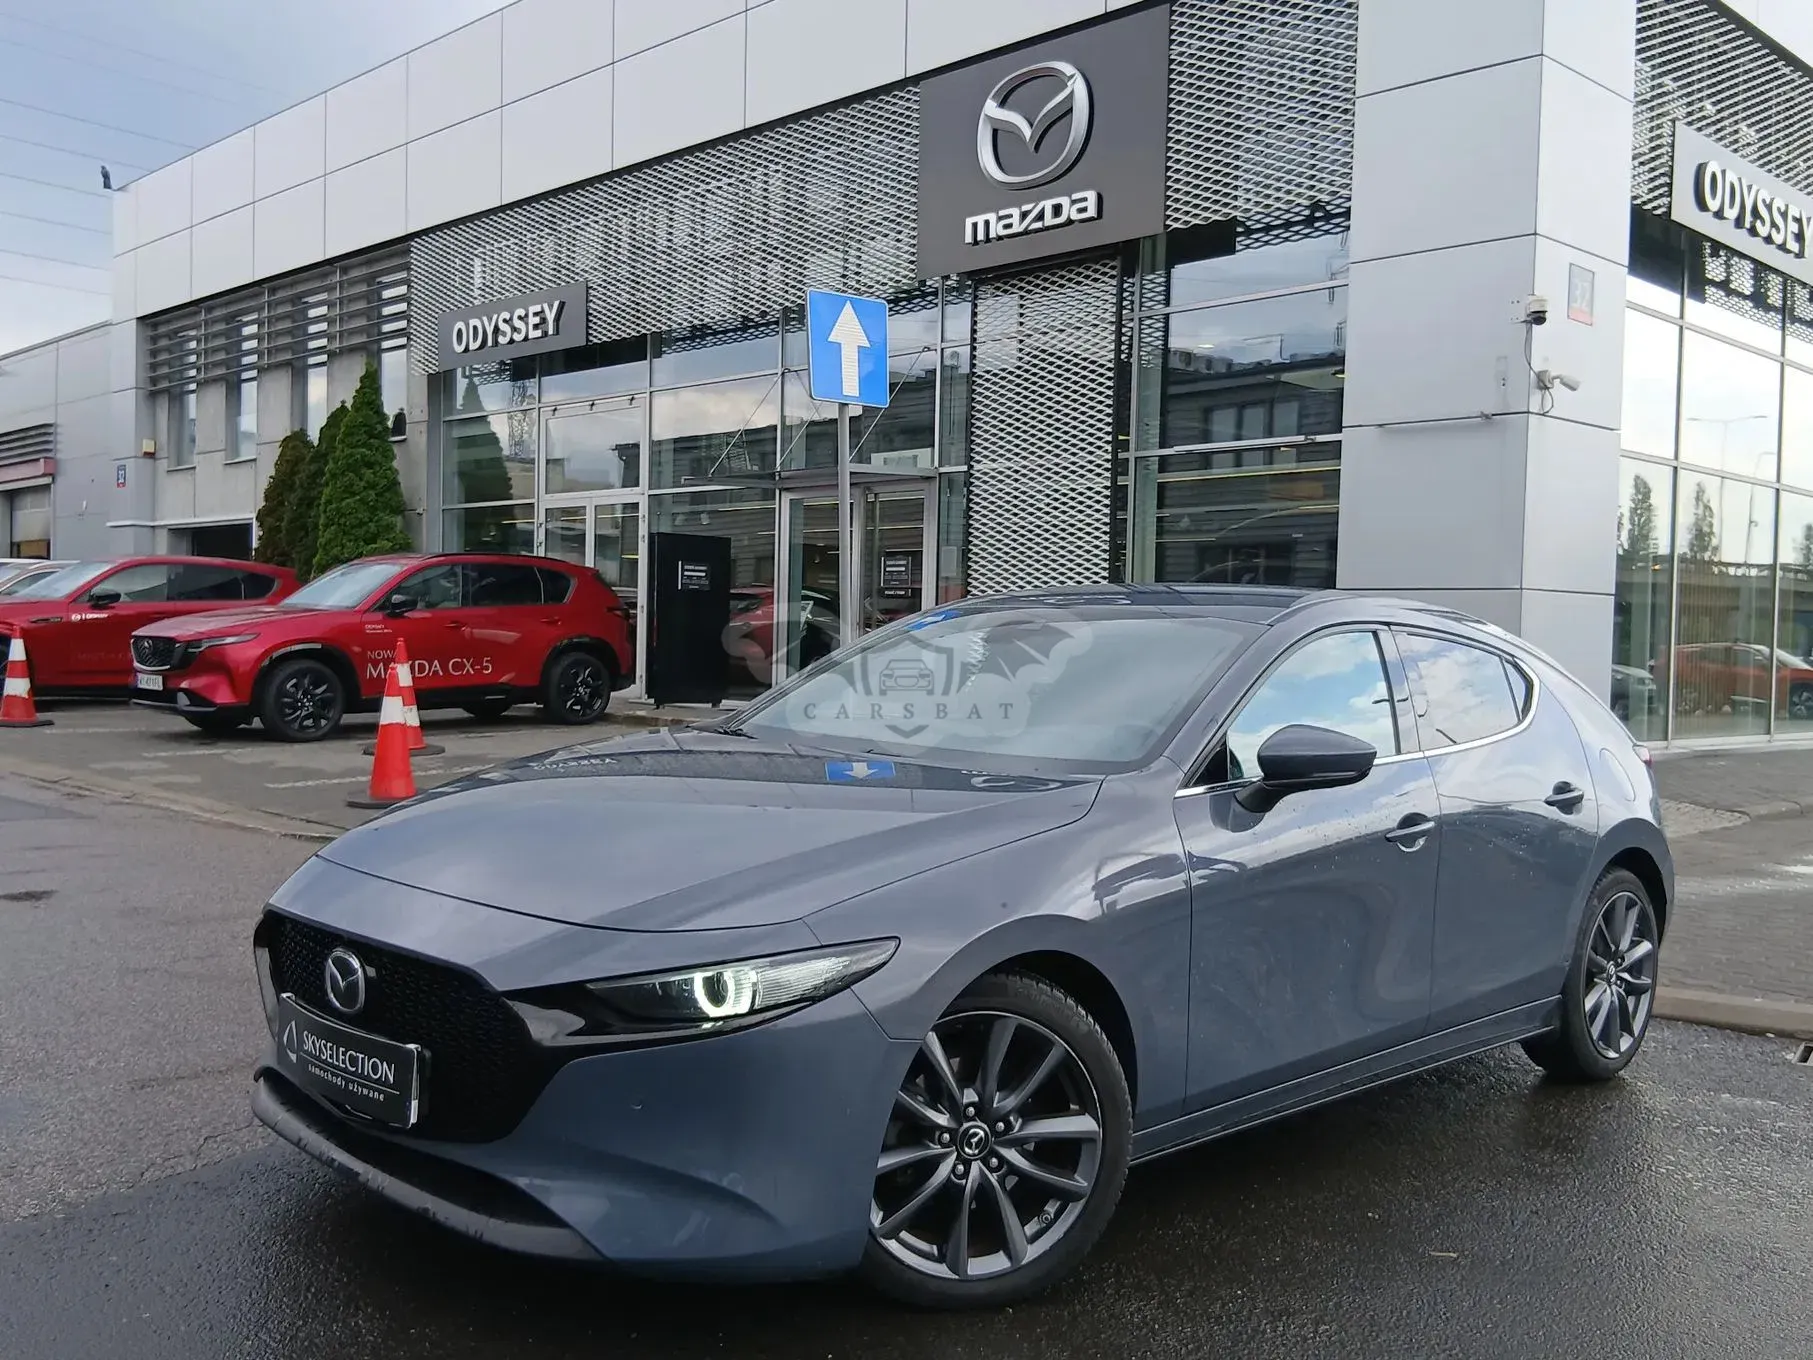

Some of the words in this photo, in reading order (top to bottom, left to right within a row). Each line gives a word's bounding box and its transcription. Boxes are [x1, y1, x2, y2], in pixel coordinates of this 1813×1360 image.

[1702, 160, 1813, 259] ODYSSEY
[452, 299, 563, 353] ODYSSEY
[366, 659, 443, 679] MDA
[448, 657, 492, 676] CX-5
[303, 1030, 395, 1084] SKYSELECTION
[308, 1063, 346, 1089] samochody
[348, 1082, 385, 1102] używane
